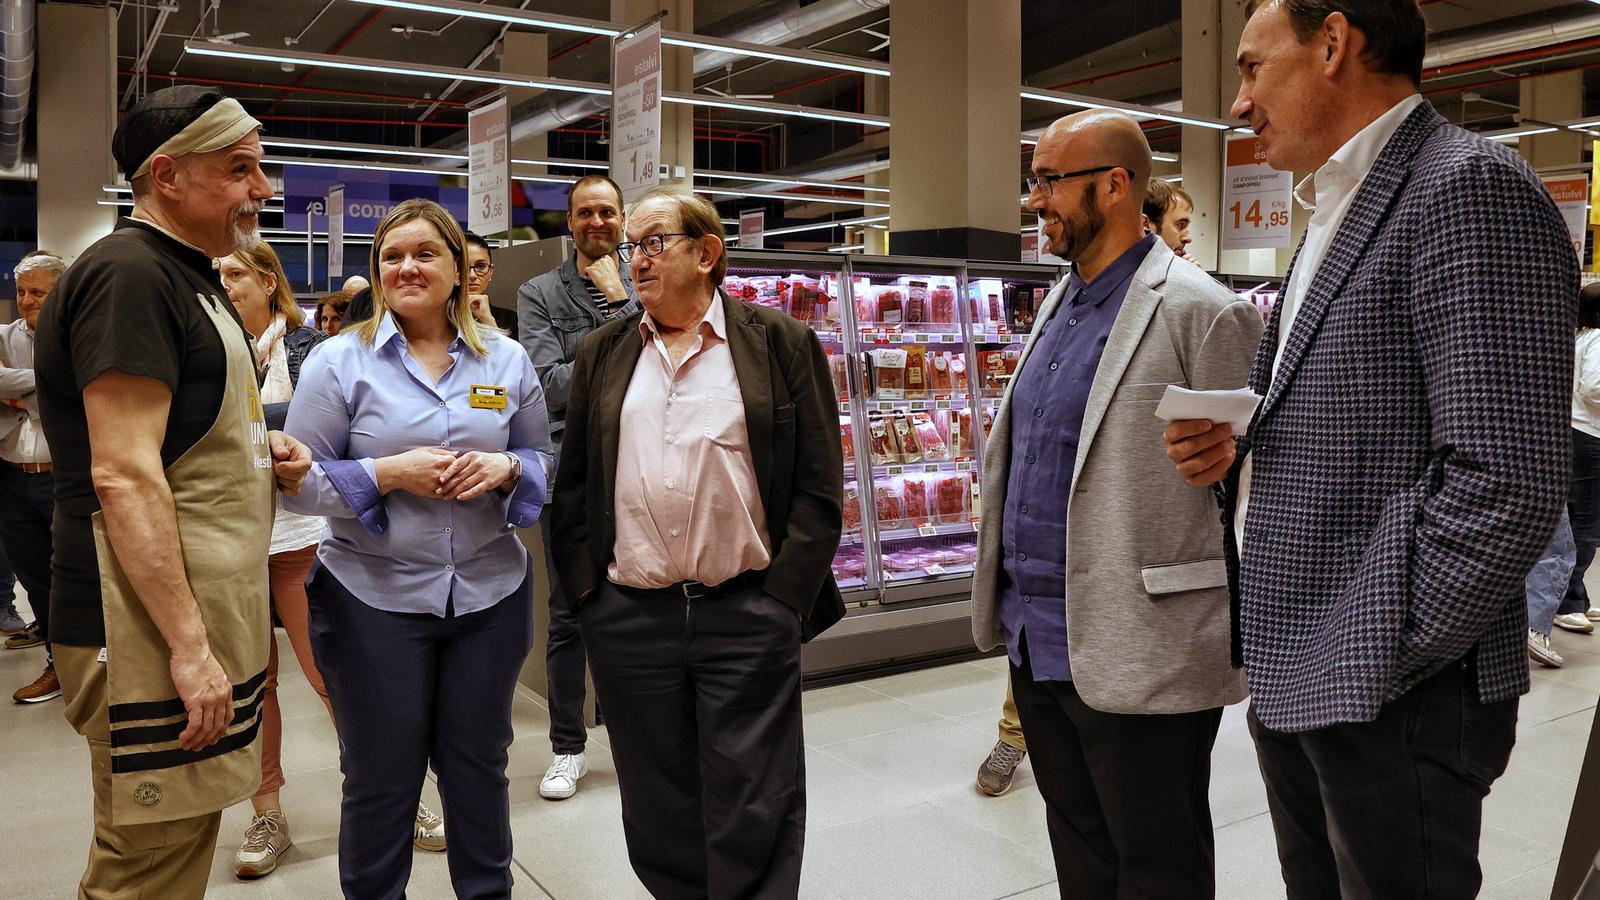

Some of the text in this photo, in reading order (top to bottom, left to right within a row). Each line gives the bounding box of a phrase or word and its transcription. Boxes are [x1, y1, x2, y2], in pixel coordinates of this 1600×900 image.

[634, 52, 657, 75] estalvi
[630, 150, 653, 184] 1,49
[482, 193, 503, 221] 3,56
[1229, 199, 1289, 230] 14,95
